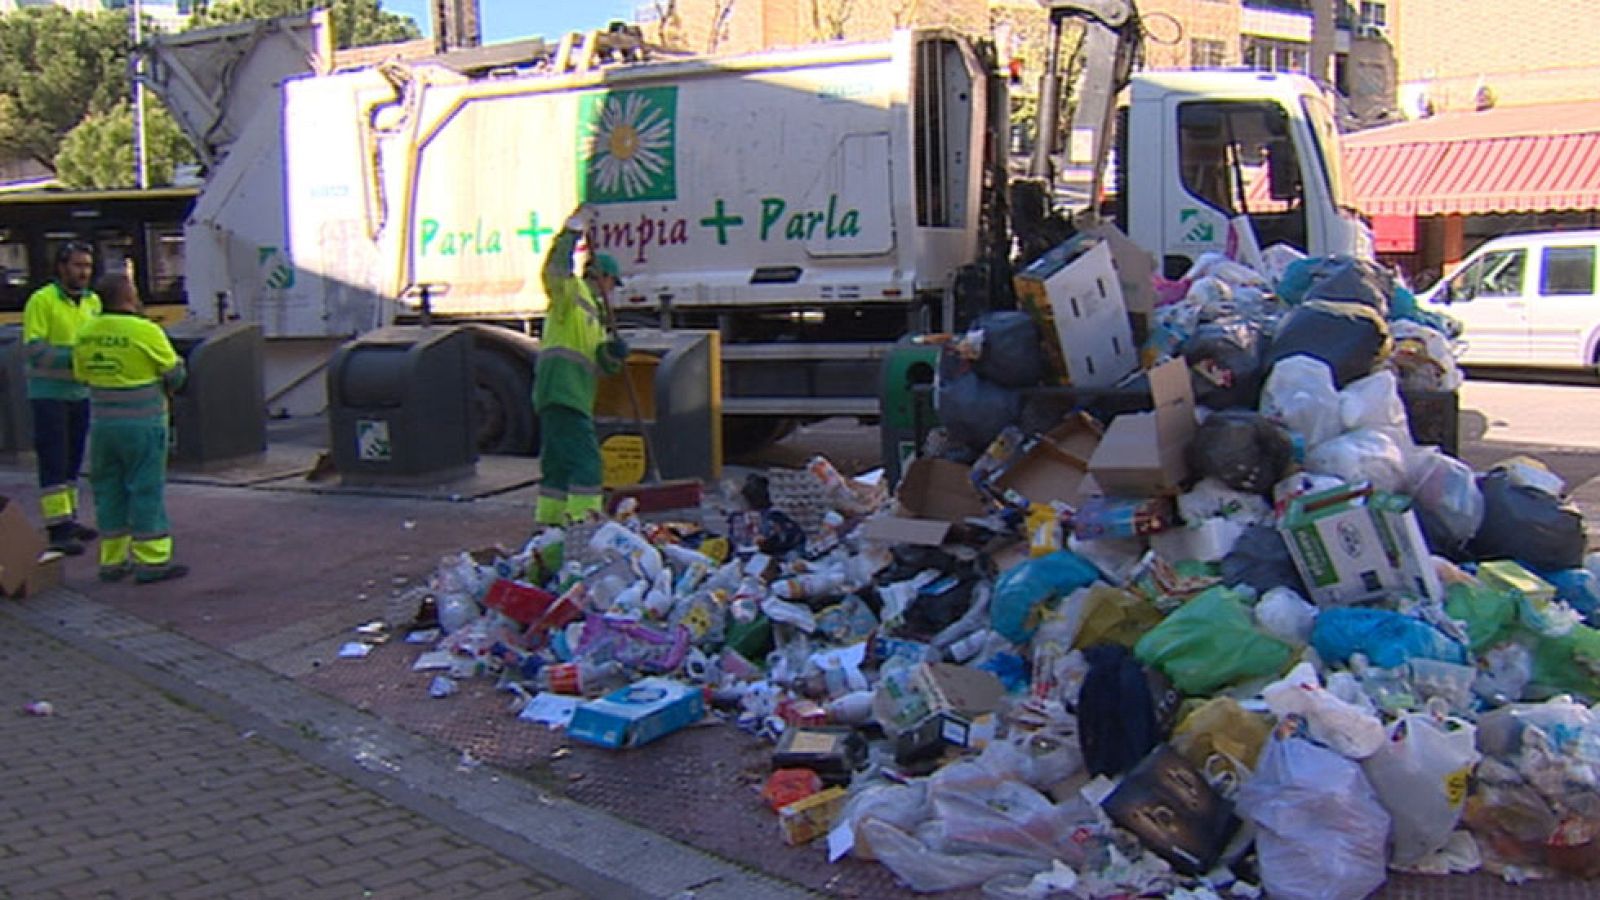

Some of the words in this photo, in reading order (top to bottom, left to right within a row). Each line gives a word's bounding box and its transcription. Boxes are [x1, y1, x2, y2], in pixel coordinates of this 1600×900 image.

[420, 216, 502, 256] Parla
[589, 205, 688, 263] impia
[760, 194, 860, 241] Parla
